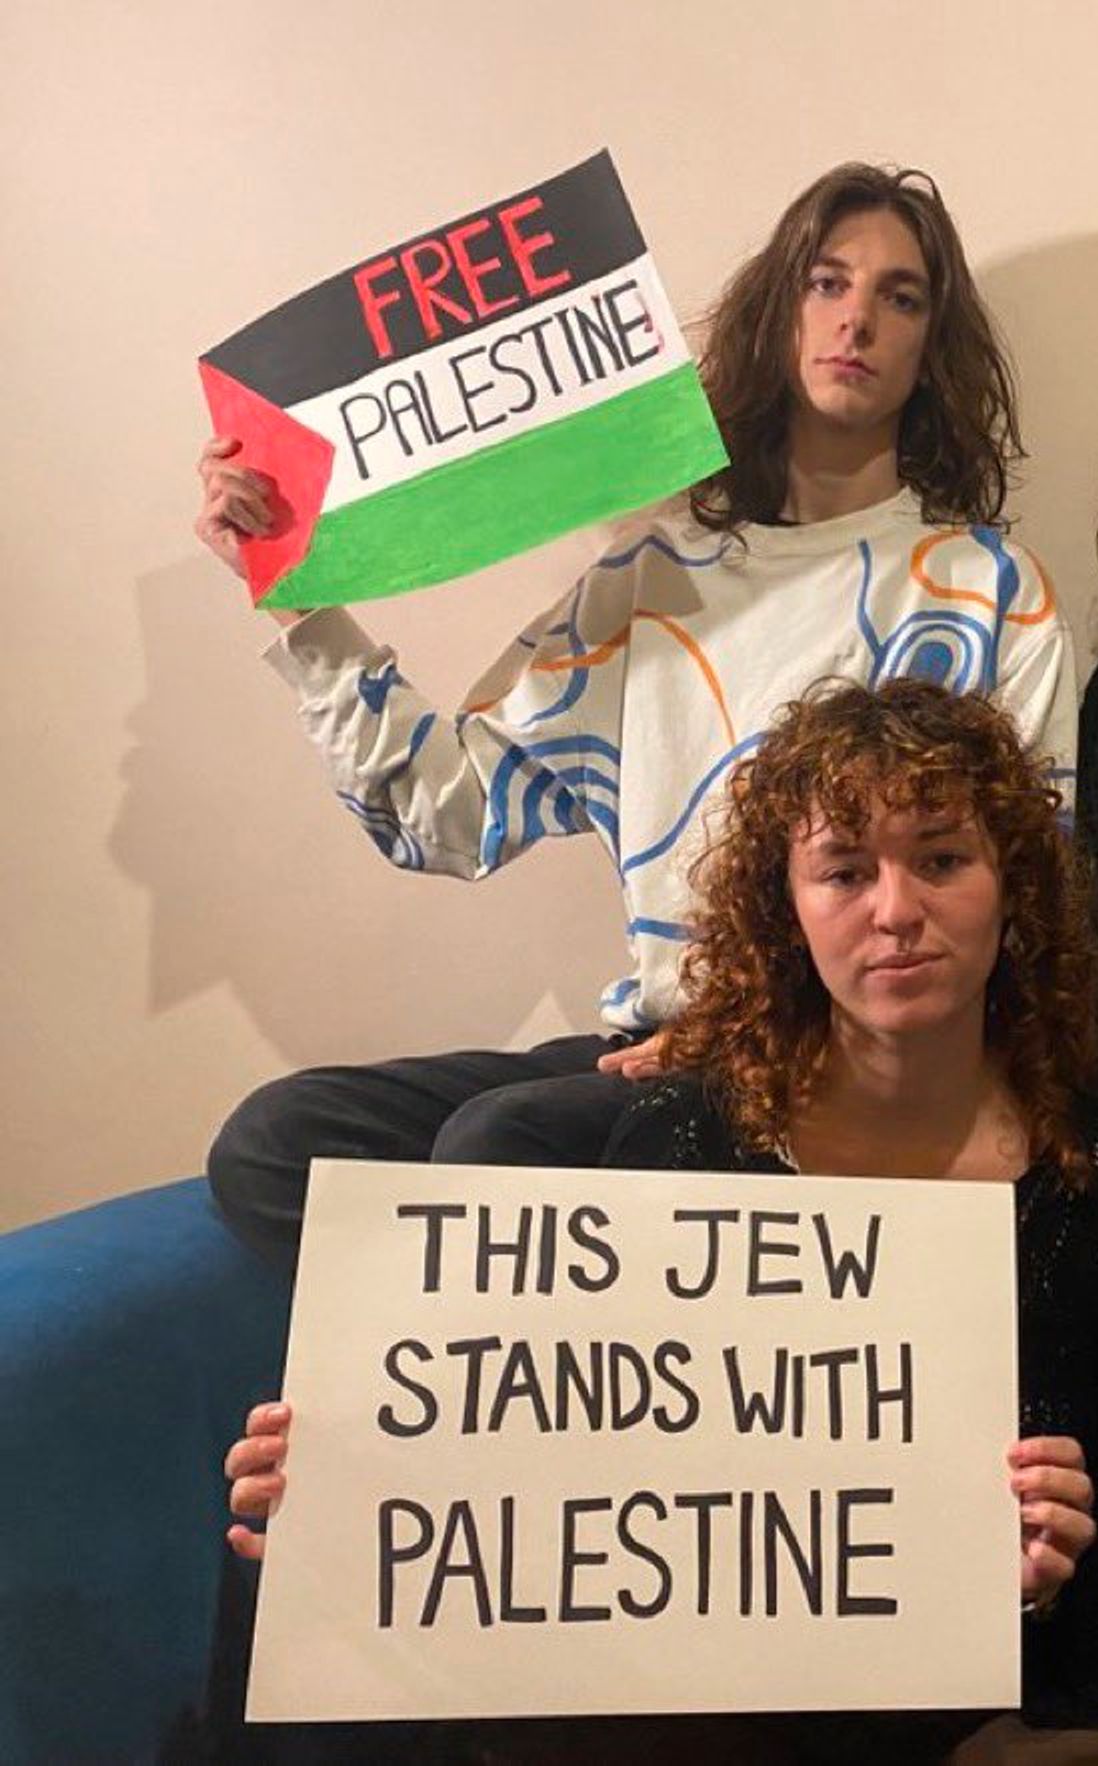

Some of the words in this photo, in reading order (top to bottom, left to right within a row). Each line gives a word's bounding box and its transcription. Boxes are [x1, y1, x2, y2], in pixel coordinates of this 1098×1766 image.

[353, 196, 571, 358] FREE
[397, 1204, 621, 1297] THIS
[665, 1208, 882, 1300] JEW
[376, 1336, 701, 1438] STANDS
[722, 1342, 914, 1443] WITH
[377, 1488, 898, 1628] PALESTINE
